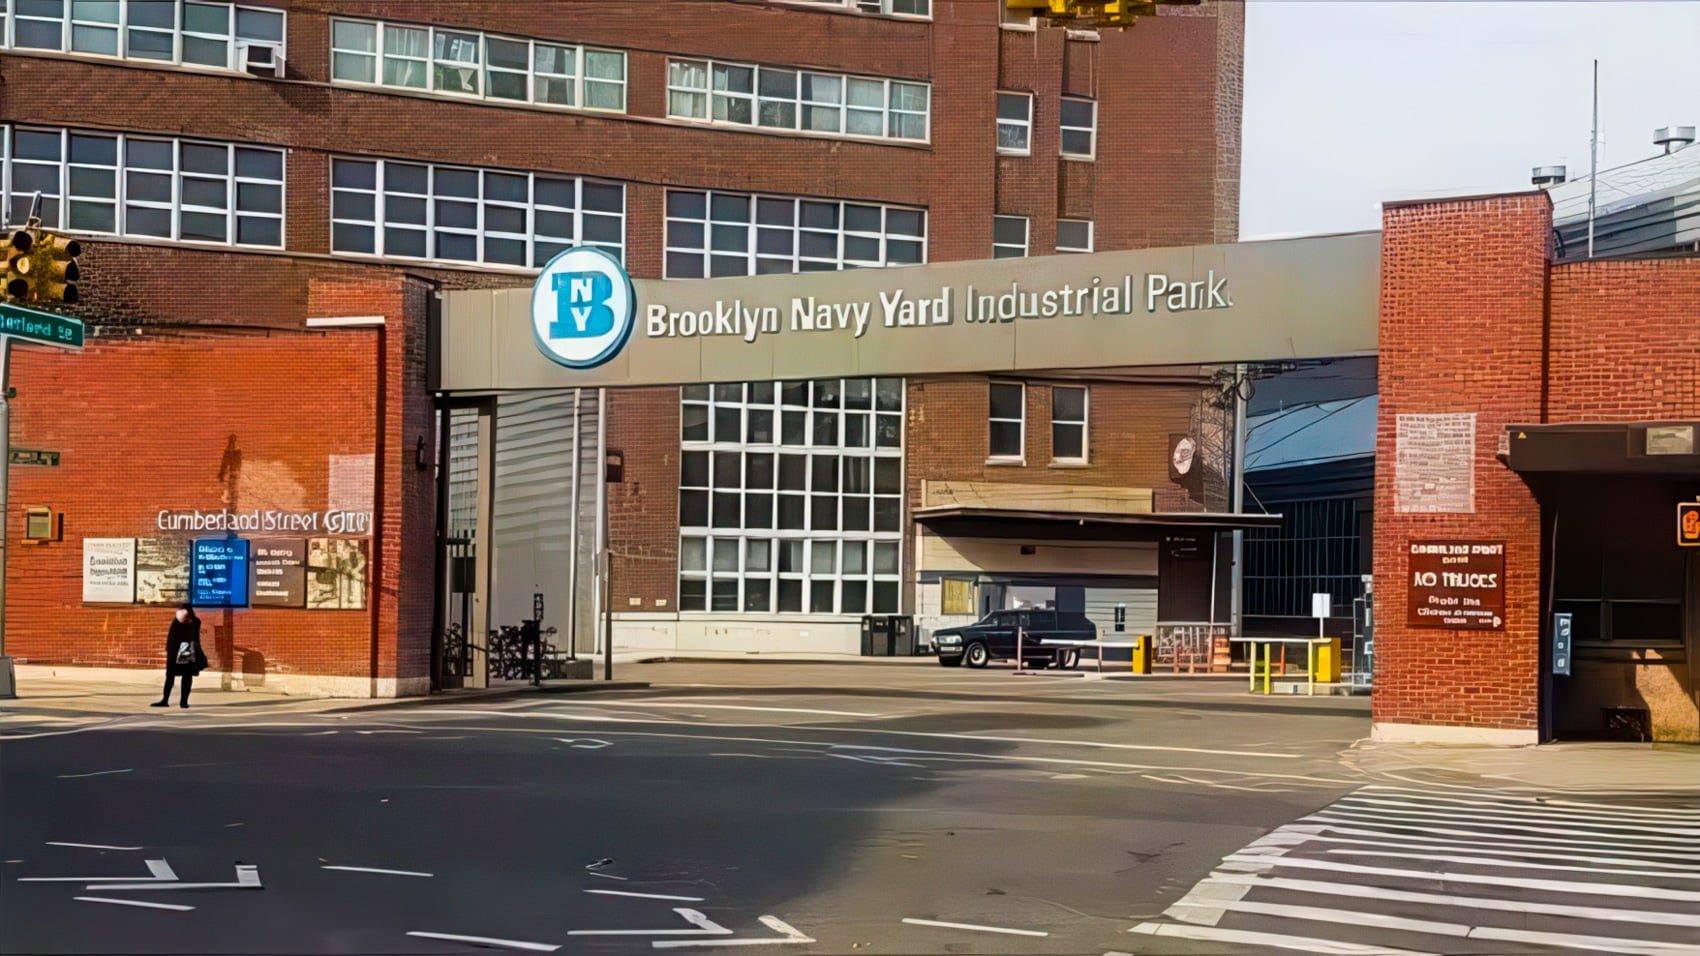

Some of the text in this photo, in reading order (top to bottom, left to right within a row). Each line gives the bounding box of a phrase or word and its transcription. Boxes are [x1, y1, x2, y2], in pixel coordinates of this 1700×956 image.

[646, 270, 1232, 343] Brooklyn Navy Yard Industrial Park
[1414, 571, 1437, 588] NO
